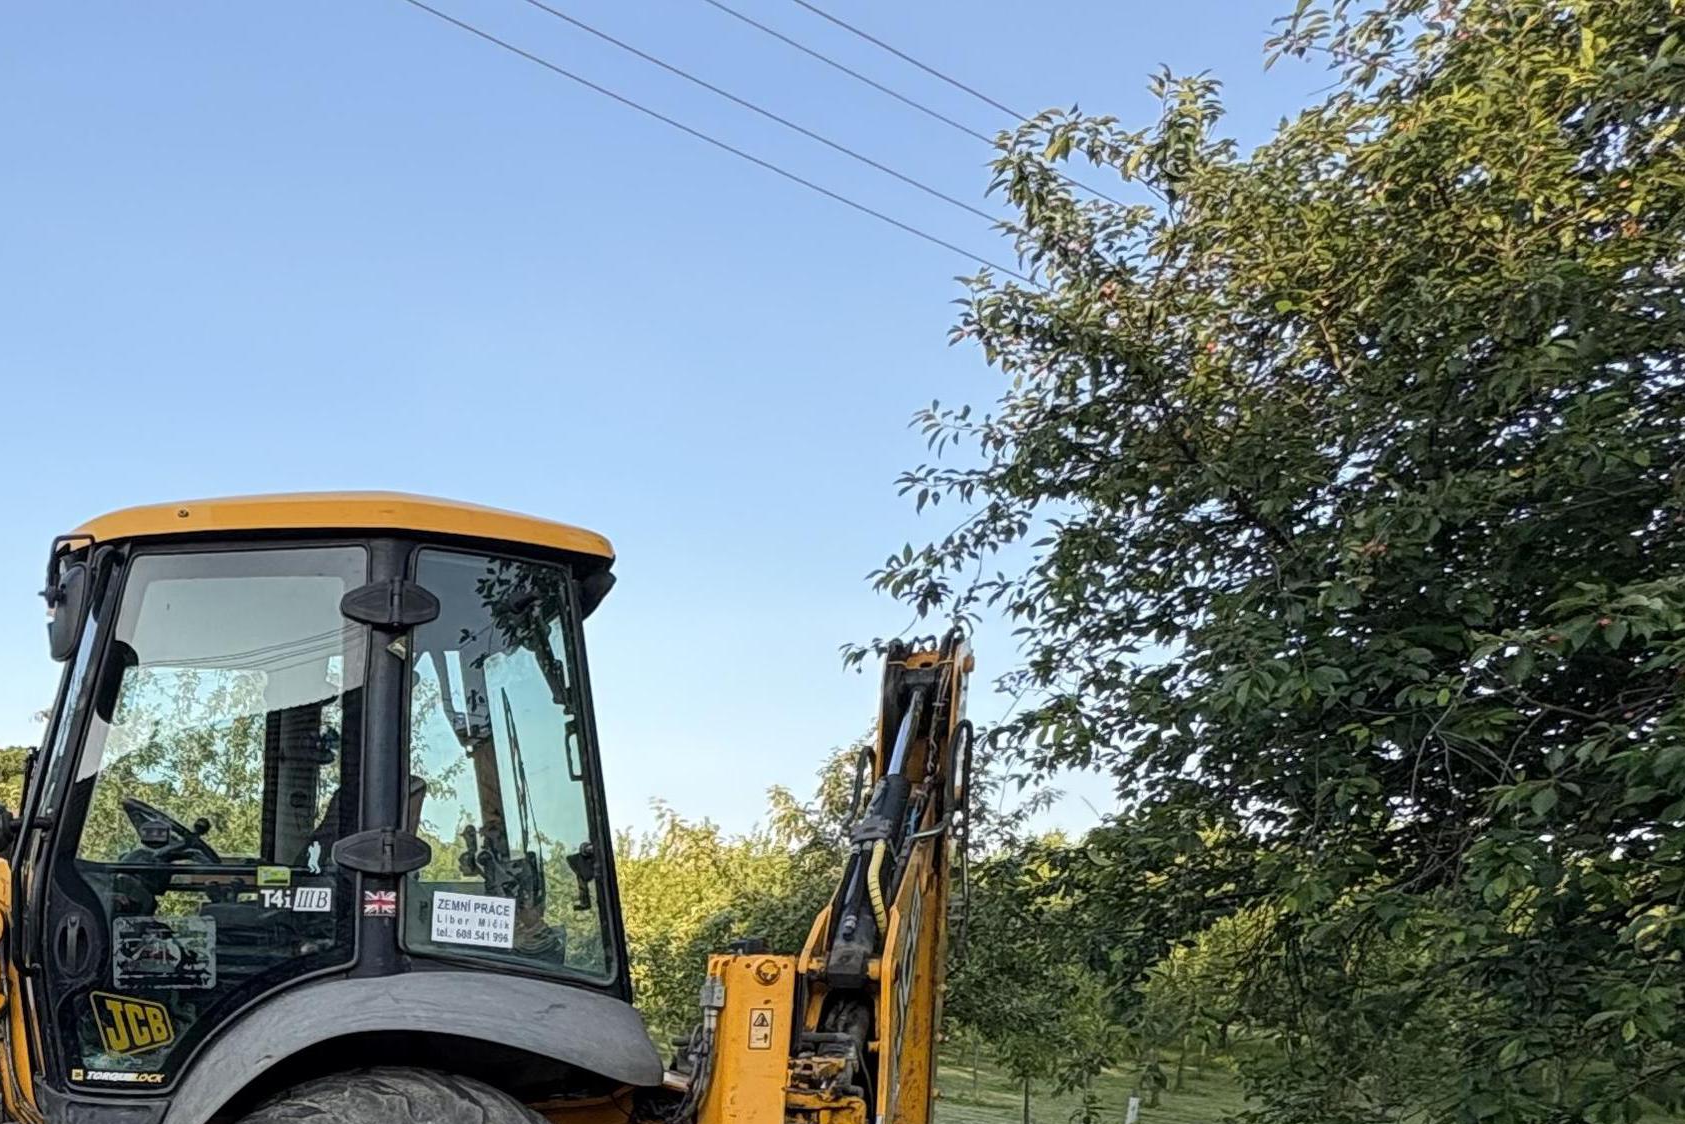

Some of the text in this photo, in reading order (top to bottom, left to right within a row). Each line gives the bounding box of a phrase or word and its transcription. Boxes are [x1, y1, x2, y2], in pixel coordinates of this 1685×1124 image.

[260, 889, 292, 908] T4i
[437, 899, 510, 916] ZEMNÍ PRÁCE
[437, 914, 470, 925] Libor
[105, 999, 168, 1051] JCB
